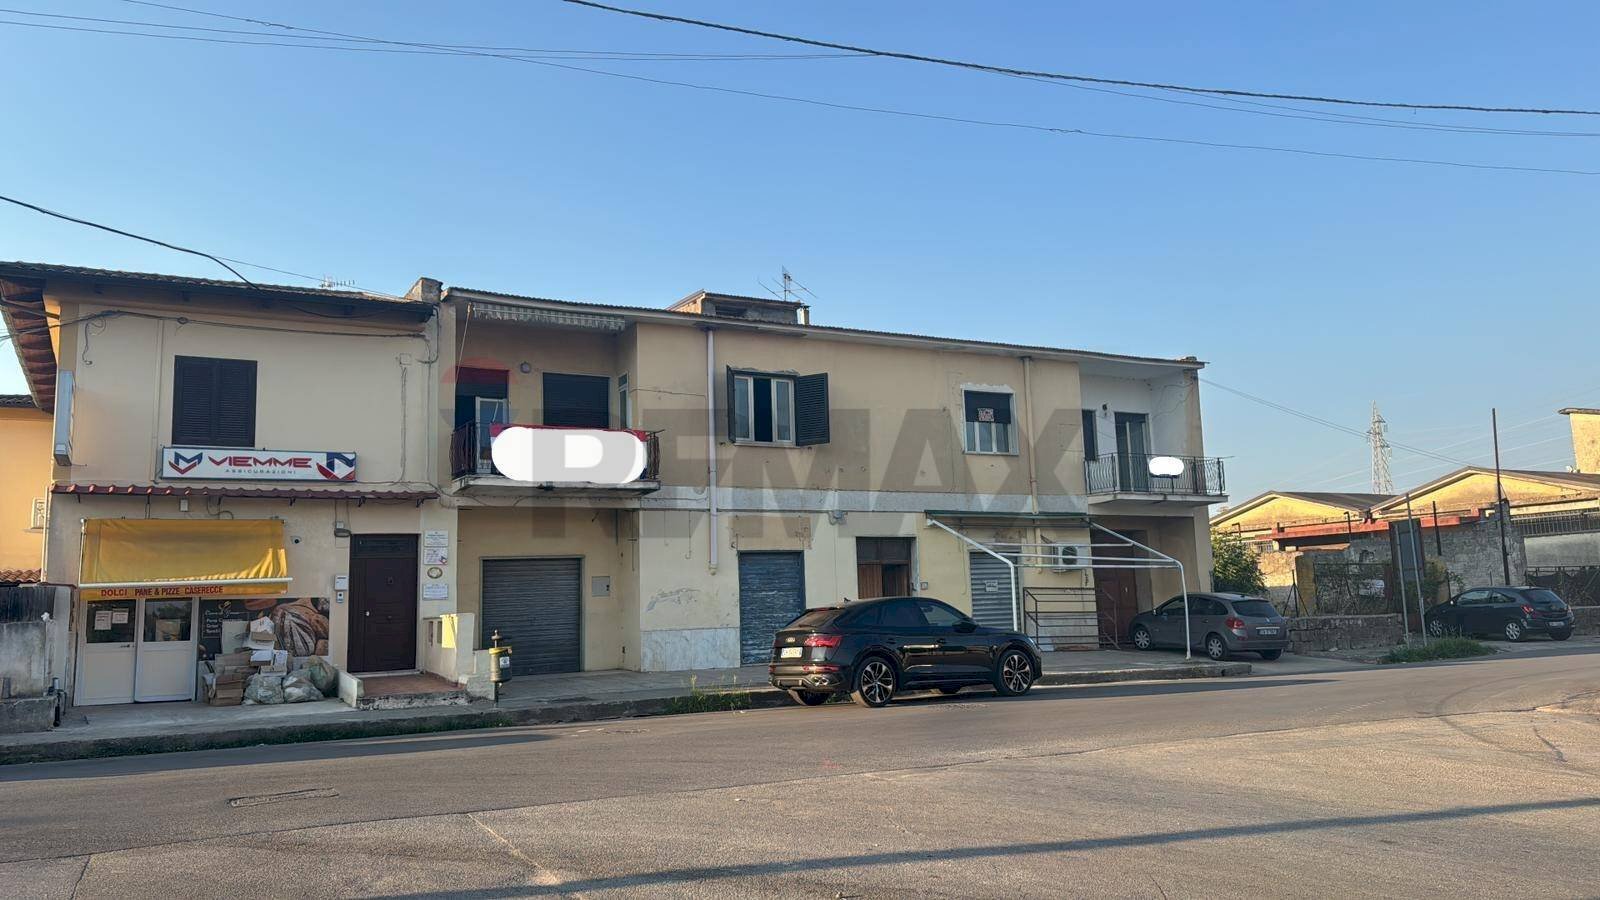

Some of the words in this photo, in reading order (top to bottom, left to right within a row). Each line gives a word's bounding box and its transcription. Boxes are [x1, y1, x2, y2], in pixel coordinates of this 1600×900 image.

[208, 456, 312, 468] VIEMME
[101, 588, 127, 597] DOLCI
[134, 588, 153, 596] PANE
[154, 587, 160, 596] &
[161, 587, 180, 595] PIZZE
[184, 585, 224, 594] CASERECCE
